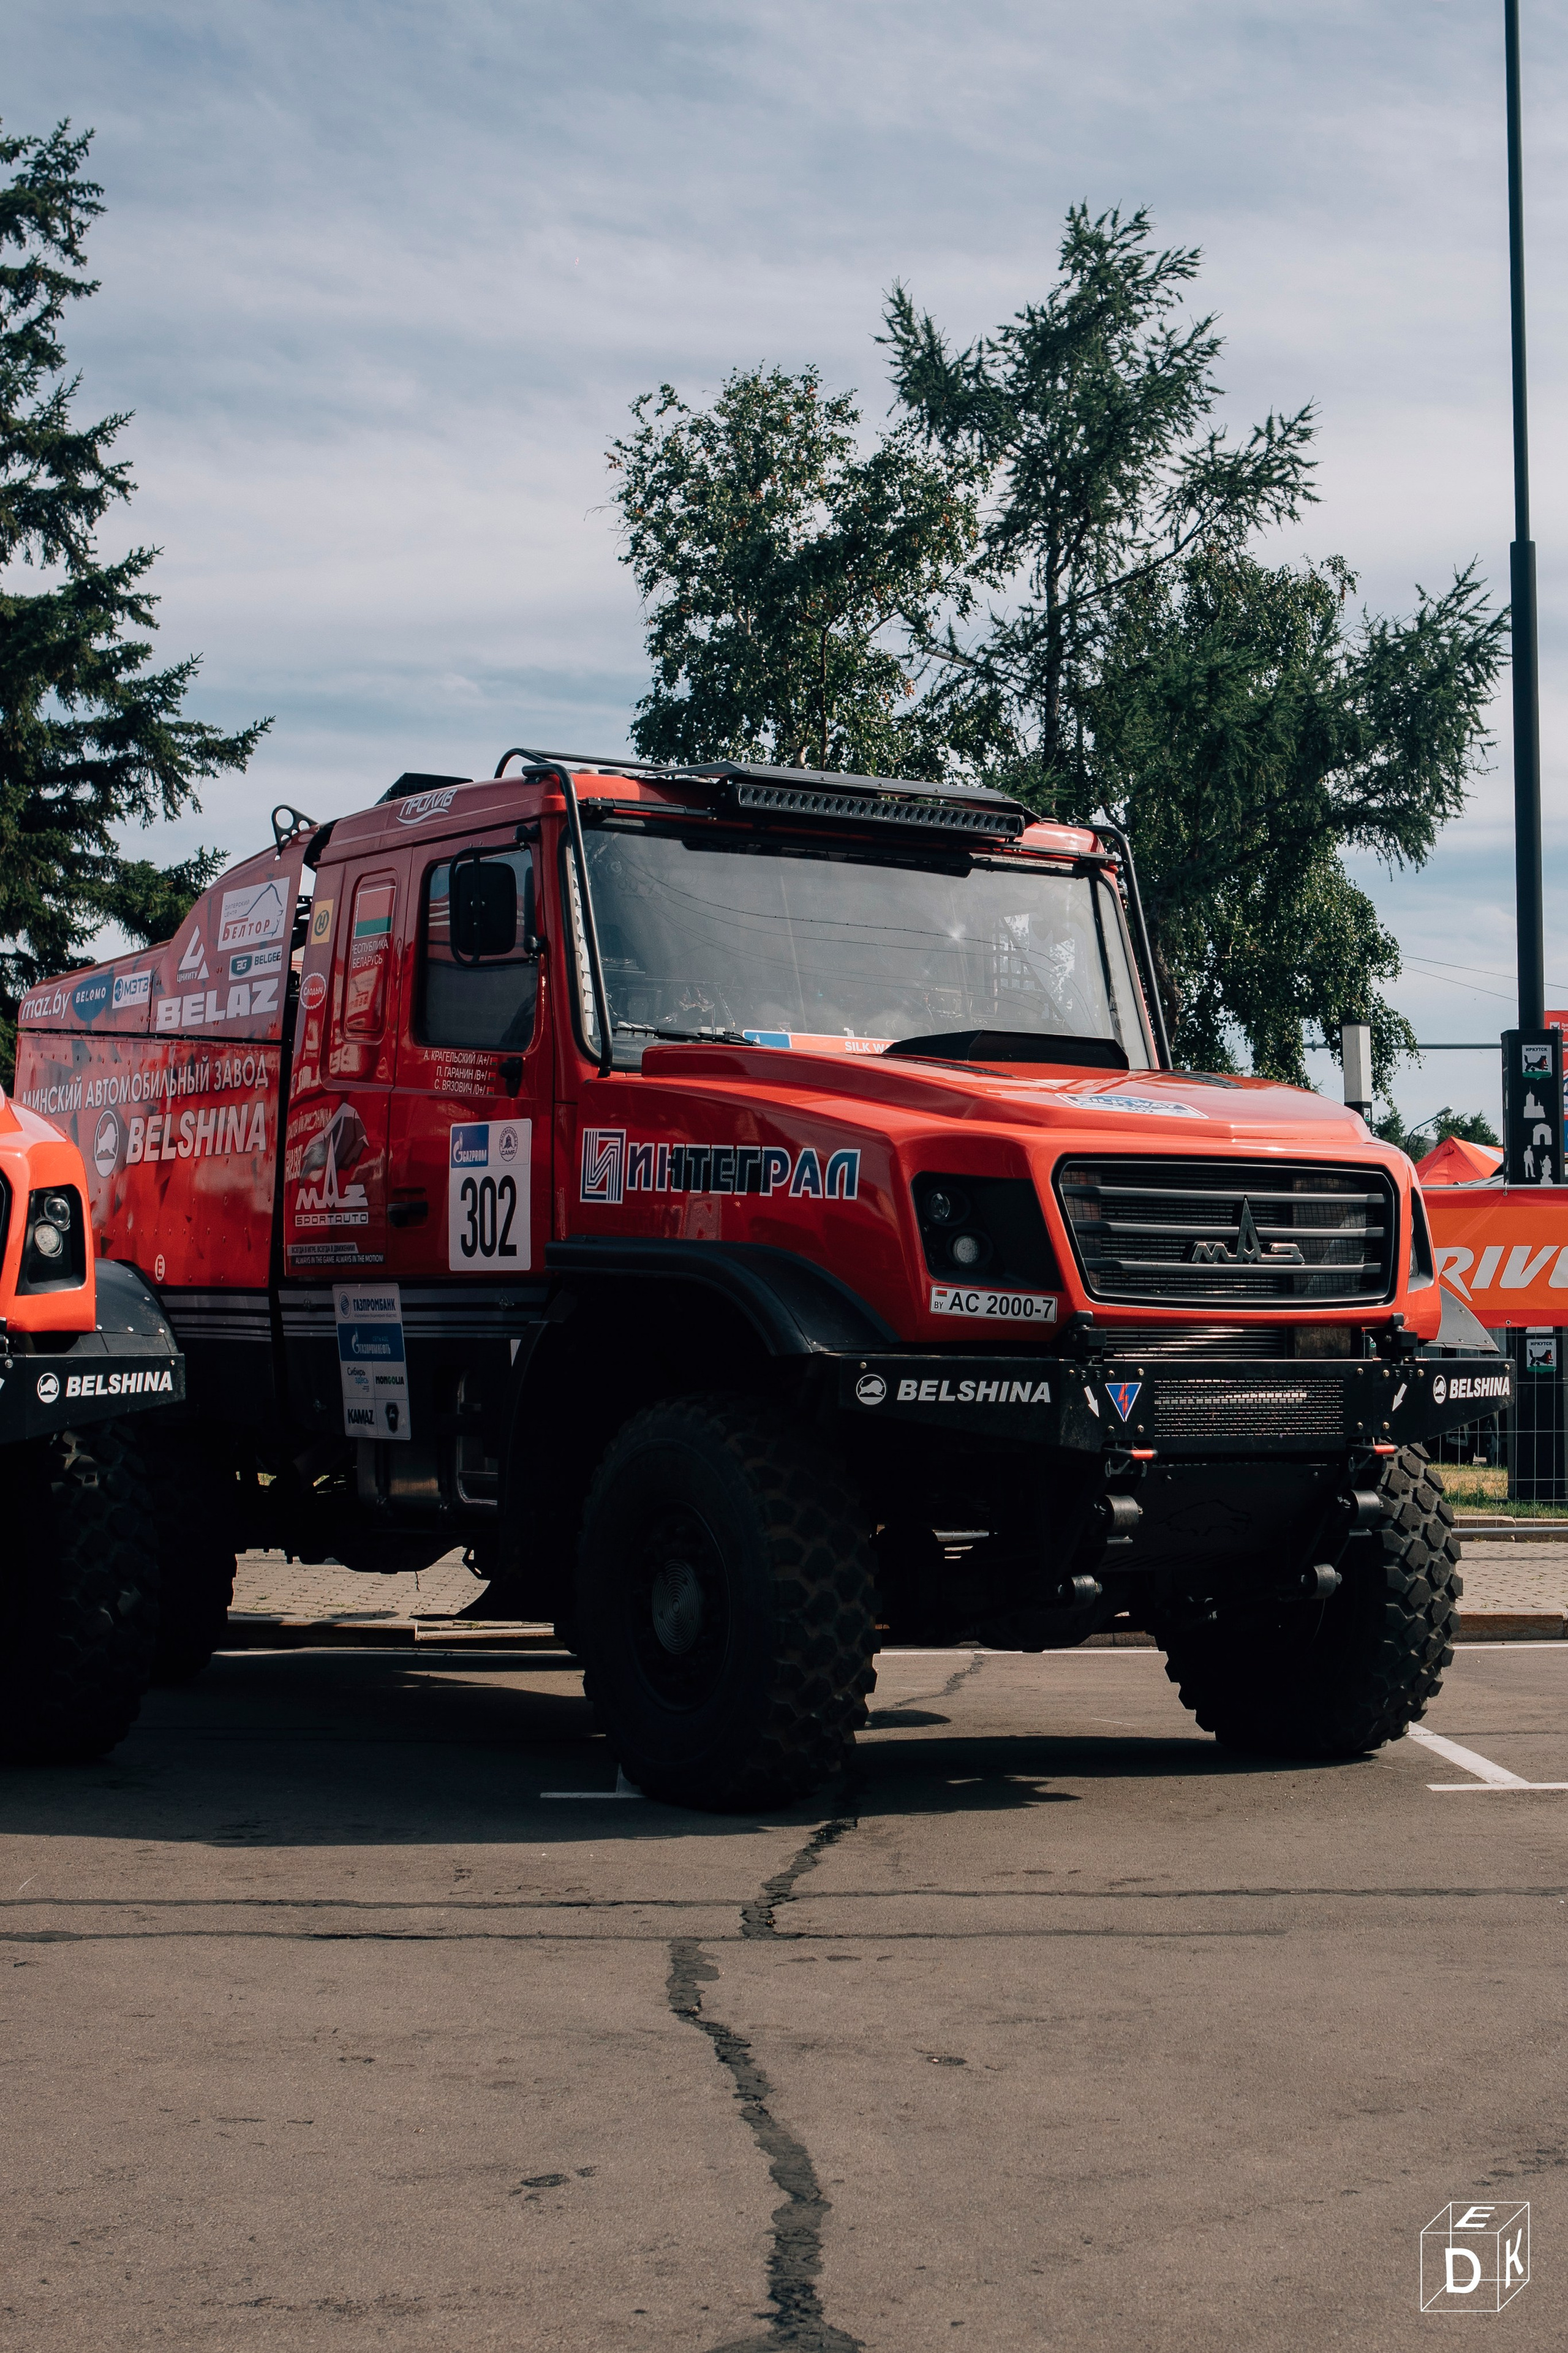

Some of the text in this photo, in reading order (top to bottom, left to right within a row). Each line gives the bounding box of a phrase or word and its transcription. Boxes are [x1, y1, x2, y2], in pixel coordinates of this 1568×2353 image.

[400, 789, 458, 816] ПРОЛИВ
[222, 918, 270, 941] БЕЛТОР
[254, 951, 281, 965] BELGEE
[352, 954, 383, 969] БЕЛАРУСЬ
[177, 971, 197, 983] ЦНИИТУ
[76, 987, 106, 1003] BELOMO
[21, 988, 71, 1020] maz.by
[156, 978, 279, 1031] BELAZ
[845, 1041, 872, 1052] SILK
[431, 1051, 475, 1064] КРАГЕЛЬСКИЙ
[437, 1066, 443, 1077] П.
[444, 1067, 473, 1079] ГАРАНИН
[85, 1056, 210, 1109] АВТОМОБИЛЬНЫЙ
[214, 1054, 268, 1089] ЗАВОД
[442, 1080, 472, 1093] ВЯЗОВИЧ
[1076, 1097, 1126, 1107] SILK
[1130, 1100, 1176, 1109] WAY
[126, 1102, 266, 1164] BELSHINA
[462, 1149, 487, 1162] GAZPROM
[626, 1143, 861, 1200] ИНТЕГРАЛ
[296, 1214, 367, 1225] SPORTAUTO
[461, 1175, 517, 1257] 302
[157, 1259, 163, 1277] E
[353, 1298, 396, 1311] ГАЗПРОМБАНК
[949, 1291, 979, 1313] AC
[986, 1295, 1054, 1318] 2000-7
[347, 1367, 366, 1377] Сибирь
[66, 1371, 173, 1397] BELSHINA
[375, 1376, 404, 1384] MONGOLIA
[897, 1380, 1051, 1403] BELSHINA
[1449, 1377, 1510, 1399] BELSHINA
[347, 1409, 374, 1424] KAMAZ
